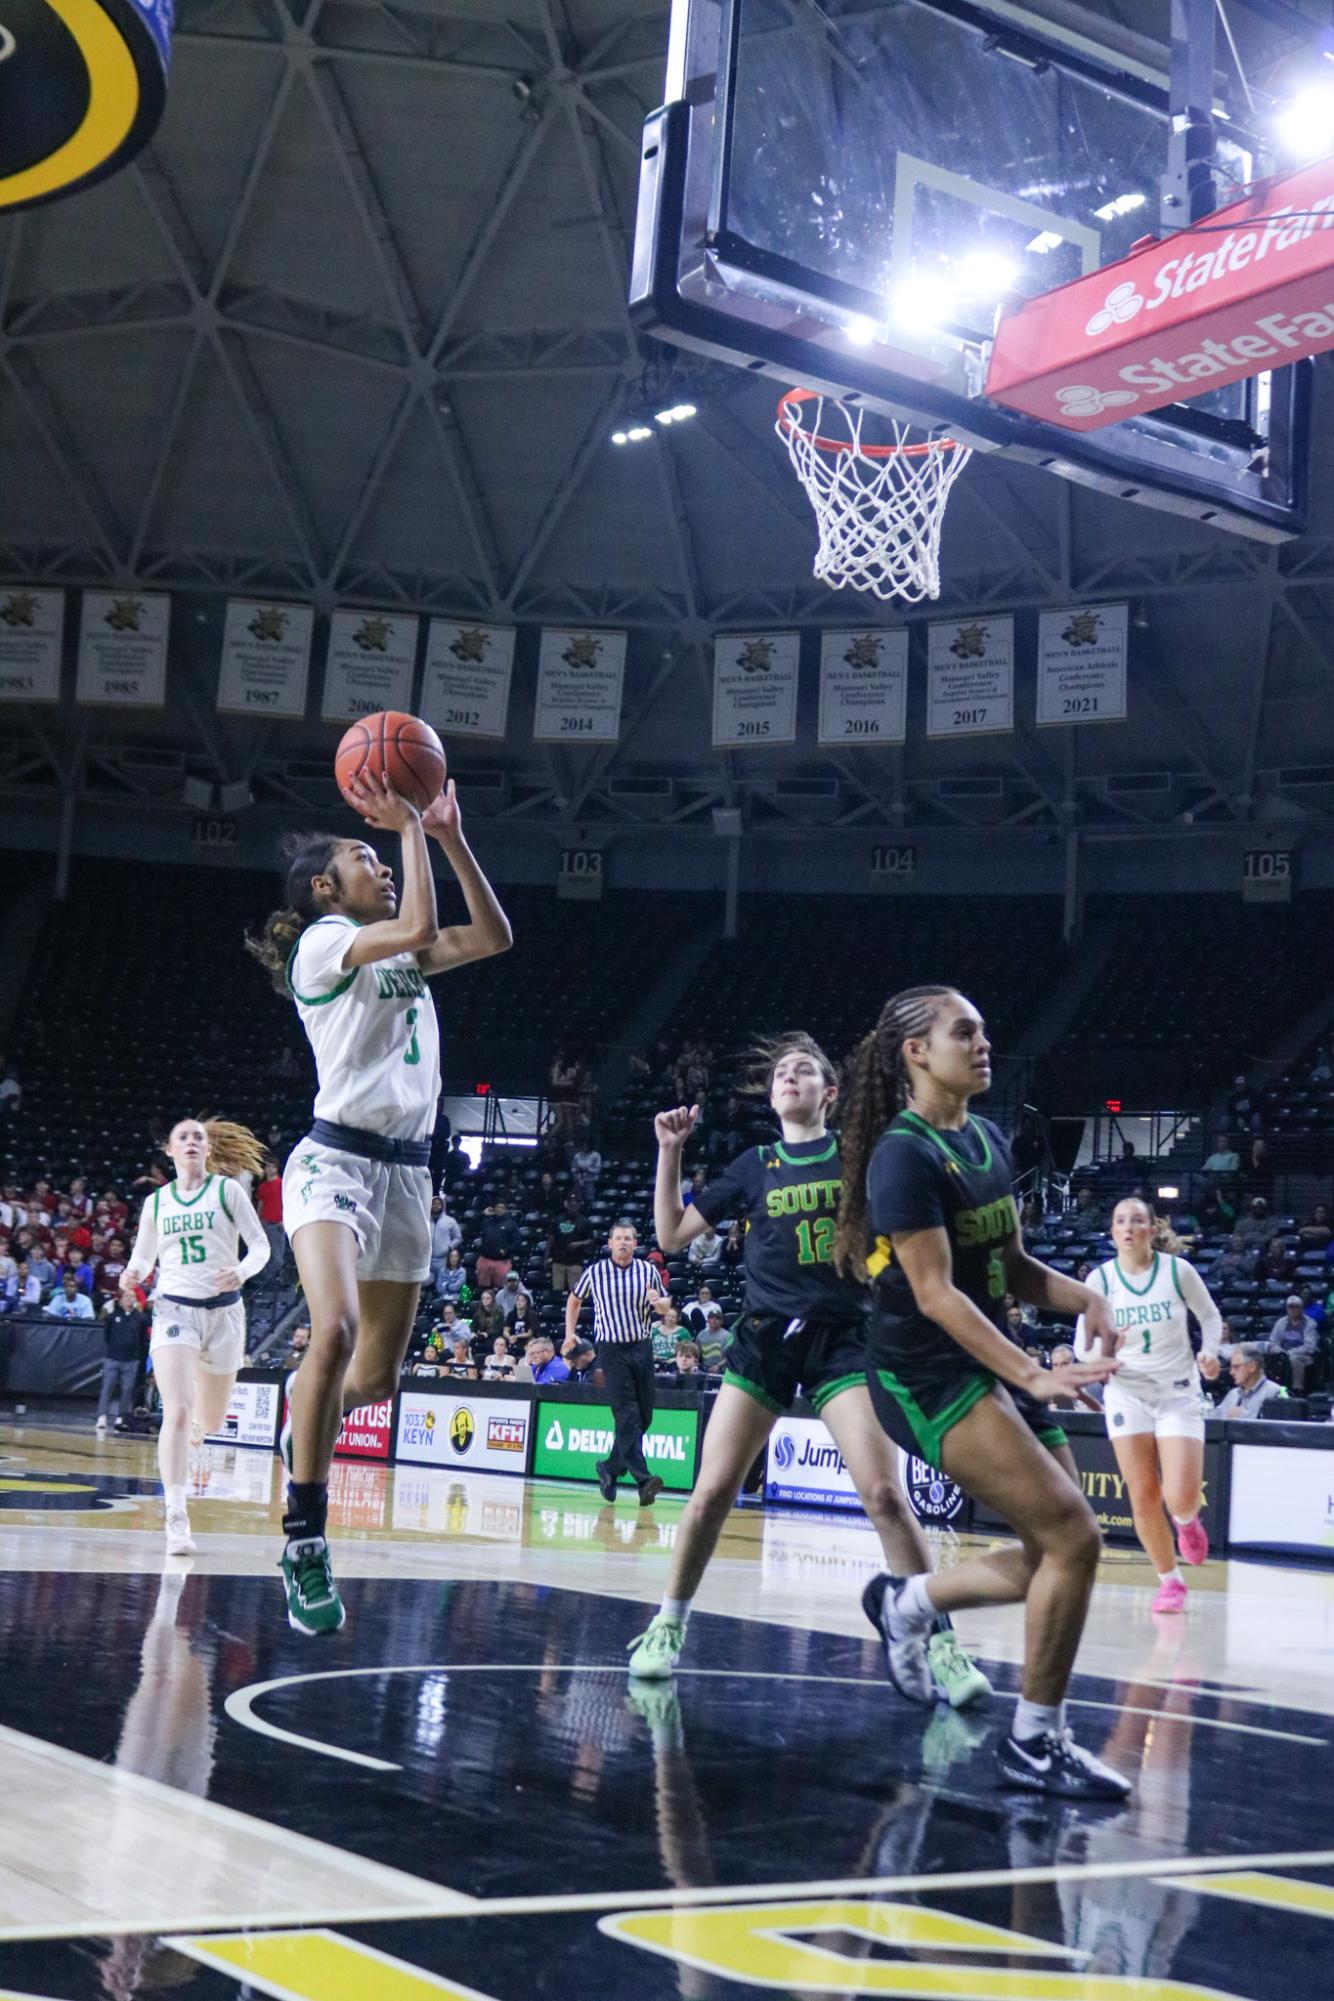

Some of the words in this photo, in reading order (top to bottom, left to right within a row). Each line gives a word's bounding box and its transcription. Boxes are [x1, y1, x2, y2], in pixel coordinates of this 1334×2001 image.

[1045, 650, 1069, 659] MEN'S
[1070, 645, 1121, 657] BASKETBALL
[934, 663, 957, 672] MEN'S
[958, 657, 1008, 670] BASKETBALL
[1046, 664, 1085, 674] American
[1087, 661, 1119, 671] Athletic
[720, 675, 742, 683] MEN'S
[744, 673, 792, 682] BASKETBALL
[827, 672, 850, 680] MEN'S
[852, 670, 900, 680] BASKETBALL
[940, 674, 975, 683] Missouri
[976, 671, 1000, 681] Valley
[1058, 673, 1105, 682] Conference
[834, 684, 867, 693] Missouri
[869, 684, 893, 692] Valley
[840, 691, 885, 699] Conference
[1058, 681, 1105, 692] Champions
[245, 689, 280, 704] 1987
[1063, 698, 1099, 714] 2021
[446, 709, 479, 726] 2012
[560, 717, 593, 731] 2014
[953, 708, 988, 725] 2017
[737, 721, 770, 737] 2015
[845, 719, 879, 734] 2016
[193, 820, 237, 844] 102
[560, 851, 602, 875] 103
[873, 847, 914, 872] 104
[1246, 853, 1289, 879] 105
[767, 1180, 844, 1218] SOUT
[163, 1211, 215, 1235] DERBY
[955, 1194, 1015, 1246] SOUT
[795, 1217, 836, 1264] 12
[179, 1234, 206, 1265] 15
[1115, 1300, 1172, 1328] DERBY
[1141, 1329, 1151, 1354] 1
[405, 1413, 426, 1427] 103.7
[348, 1431, 378, 1448] UNION
[403, 1428, 435, 1446] KEYN
[489, 1423, 524, 1443] KFH
[793, 1490, 825, 1503] LOCATIONS
[825, 1493, 834, 1503] AT
[834, 1494, 863, 1507] JUMPSTA
[913, 1483, 961, 1515] GASOLINE
